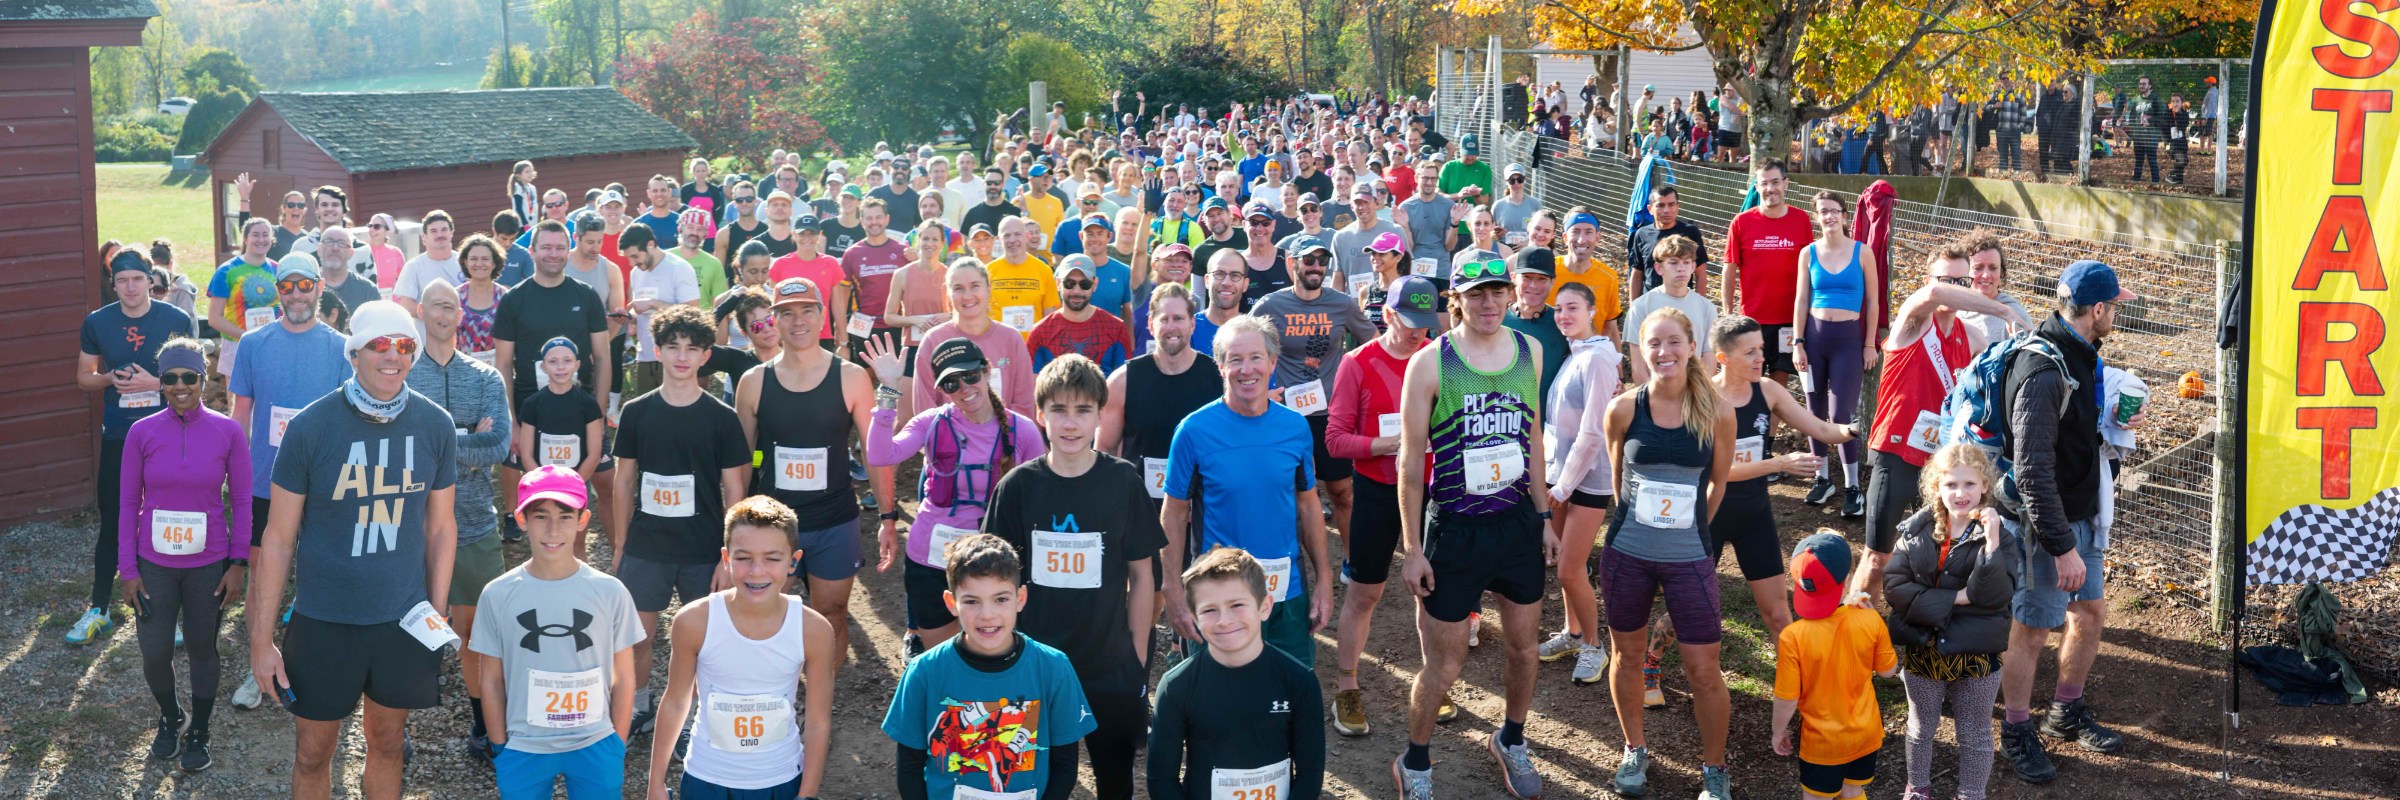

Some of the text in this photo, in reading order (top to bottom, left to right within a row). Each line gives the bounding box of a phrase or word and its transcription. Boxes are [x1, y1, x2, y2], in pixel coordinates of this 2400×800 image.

[2292, 0, 2400, 499] START
[1284, 313, 1332, 326] TRAIL
[1285, 324, 1333, 337] RUN IT
[1295, 392, 1317, 408] 616
[1463, 393, 1488, 413] PLT
[1464, 408, 1522, 437] racing
[548, 446, 571, 460] 128
[332, 436, 424, 500] ALL
[785, 463, 815, 479] 490
[1491, 463, 1501, 481] 3
[653, 489, 680, 506] 491
[1660, 498, 1672, 516] 2
[352, 498, 404, 556] IN
[1653, 515, 1676, 525] LINDSEY
[163, 526, 194, 544] 464
[1047, 551, 1085, 574] 510
[545, 690, 588, 713] 246
[734, 716, 764, 738] 66
[740, 738, 759, 746] CINO
